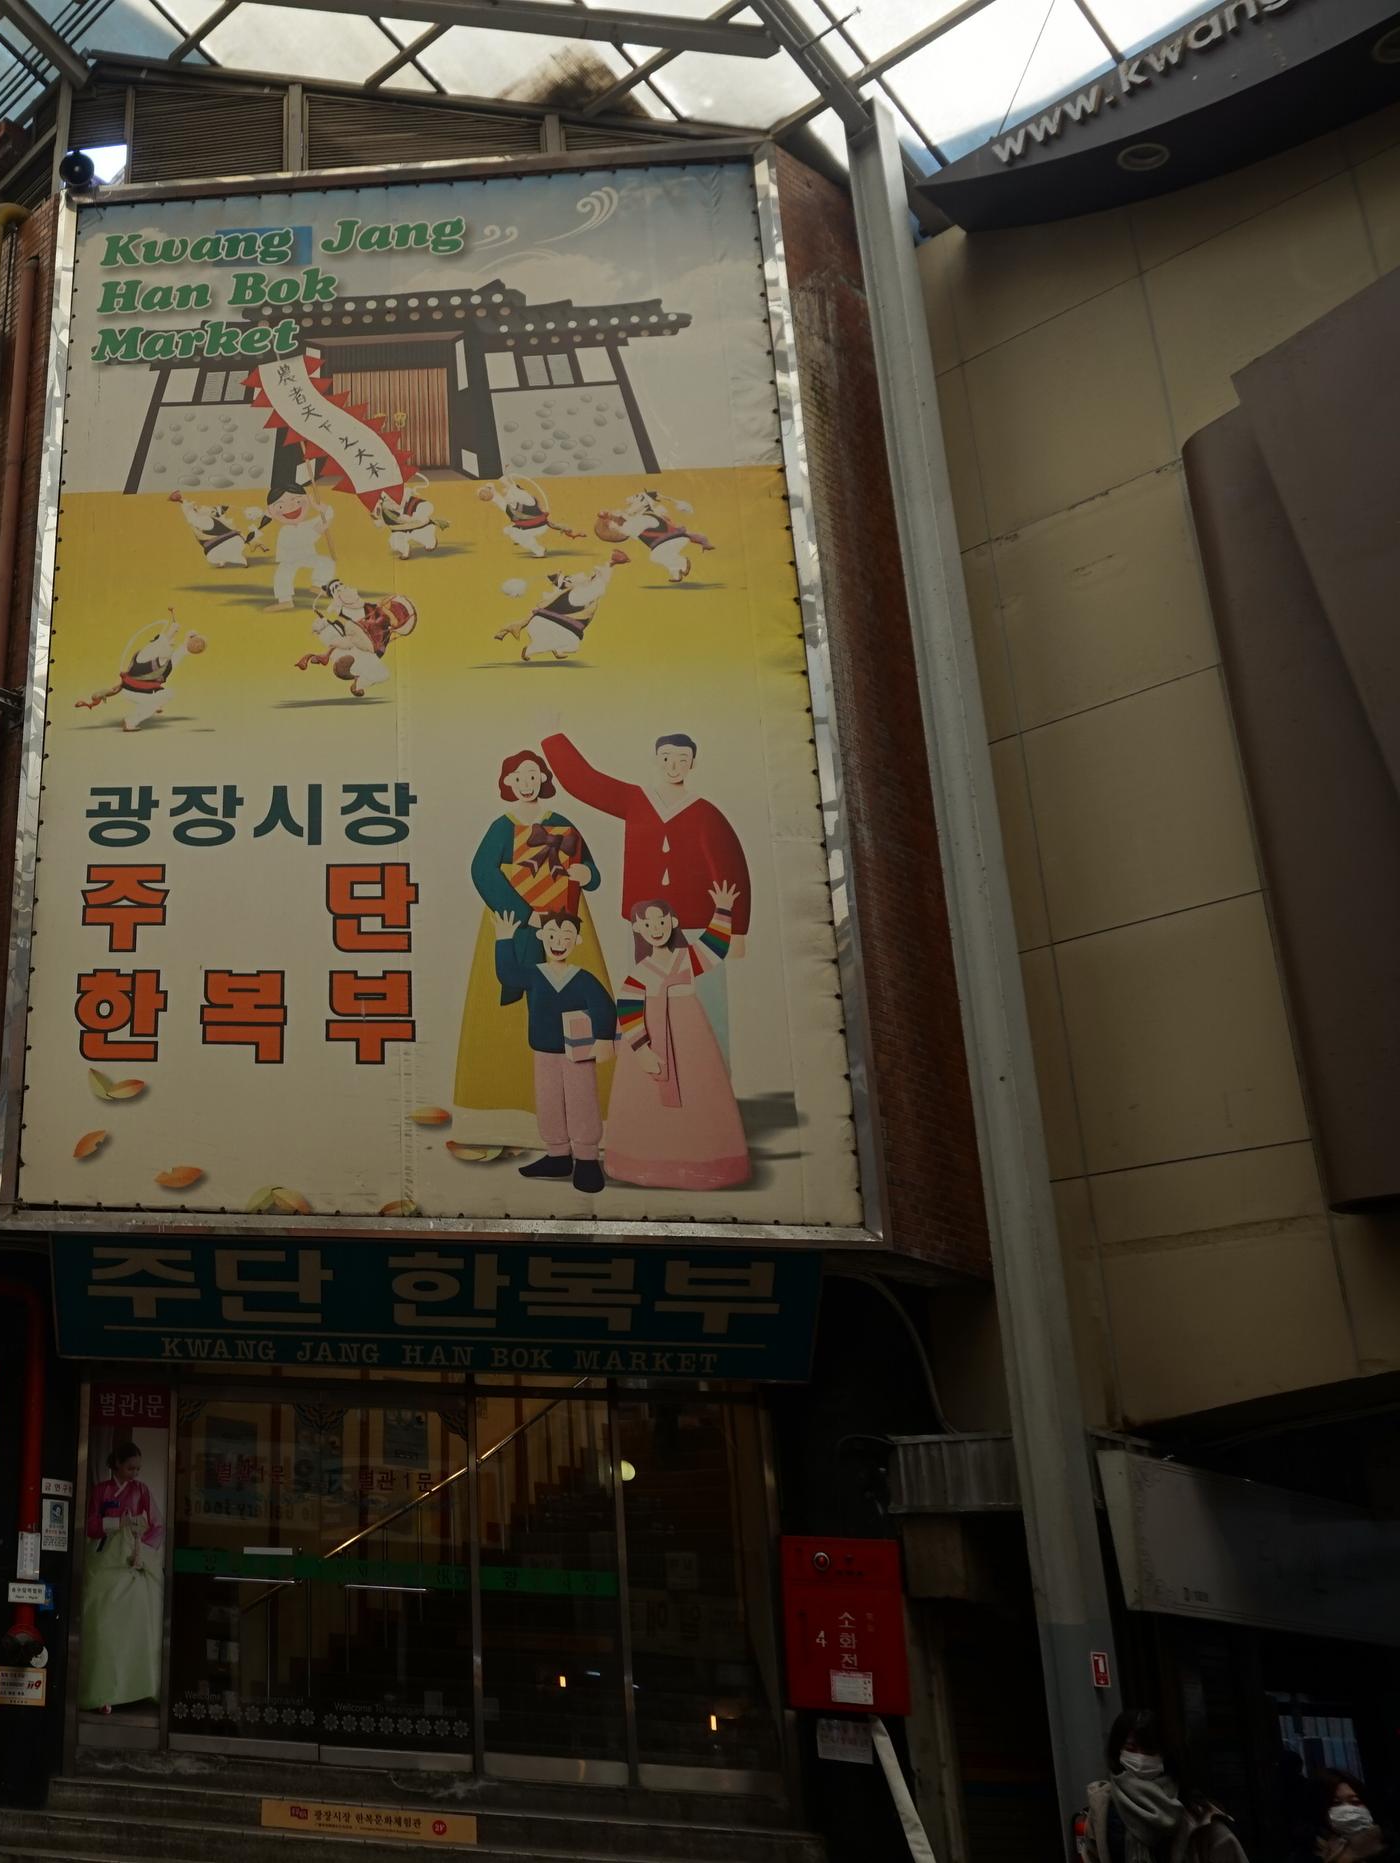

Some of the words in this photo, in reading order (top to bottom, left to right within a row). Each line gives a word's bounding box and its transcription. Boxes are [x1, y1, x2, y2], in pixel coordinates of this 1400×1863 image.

[100, 225, 294, 270] Kwang
[320, 218, 466, 258] Jang
[96, 276, 212, 316] Han
[230, 267, 339, 309] Bok
[91, 318, 301, 366] Market
[84, 781, 418, 849] 광장시장
[87, 1246, 335, 1325] 주단
[388, 1249, 782, 1335] 한복부
[160, 1336, 277, 1361] KWANG
[296, 1341, 381, 1364] JANG
[401, 1343, 474, 1367] HAN
[490, 1347, 552, 1369] BOK
[574, 1349, 720, 1375] MARKET
[98, 1392, 167, 1419] 별관1문
[815, 1630, 827, 1648] 4
[838, 1611, 858, 1670] 소화전
[314, 1809, 350, 1824] 광장시장
